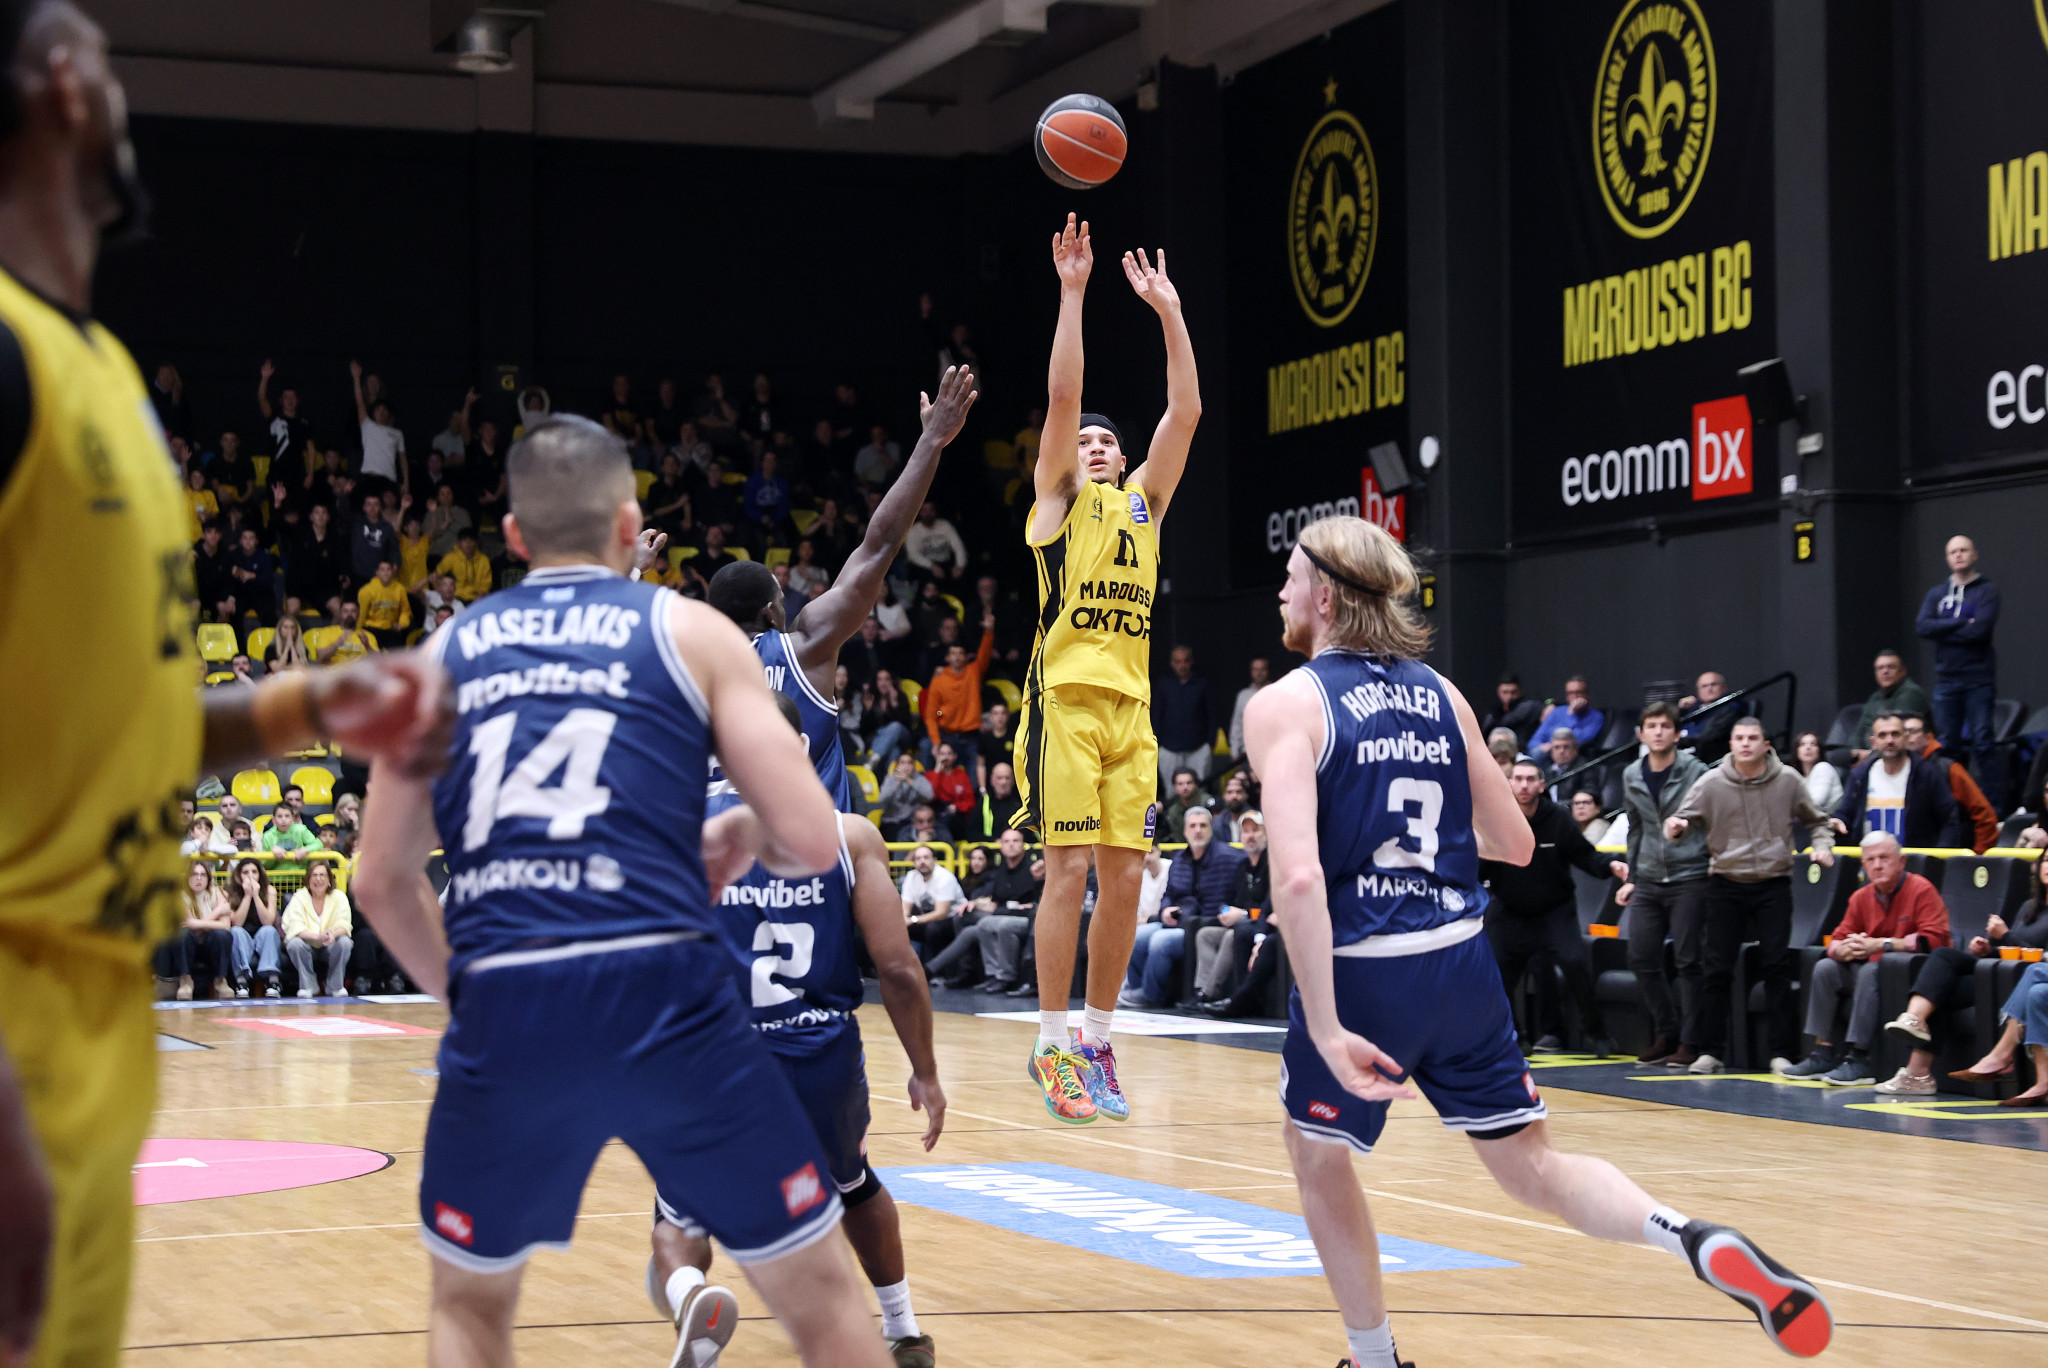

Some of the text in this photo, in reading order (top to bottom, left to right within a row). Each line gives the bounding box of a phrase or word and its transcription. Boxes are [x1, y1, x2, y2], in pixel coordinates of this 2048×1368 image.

[1563, 239, 1752, 368] MAROUSSI BC
[1268, 330, 1404, 436] MAROUSSI BC
[1798, 535, 1811, 560] B
[1424, 587, 1434, 608] B
[457, 603, 641, 661] KASELAKIS
[457, 661, 631, 715] novibet
[1357, 730, 1451, 766] novibet
[463, 707, 618, 853] 14
[1372, 776, 1444, 874] 3
[454, 857, 581, 905] MARKOU
[721, 876, 826, 908] novibet
[751, 919, 816, 1008] 2
